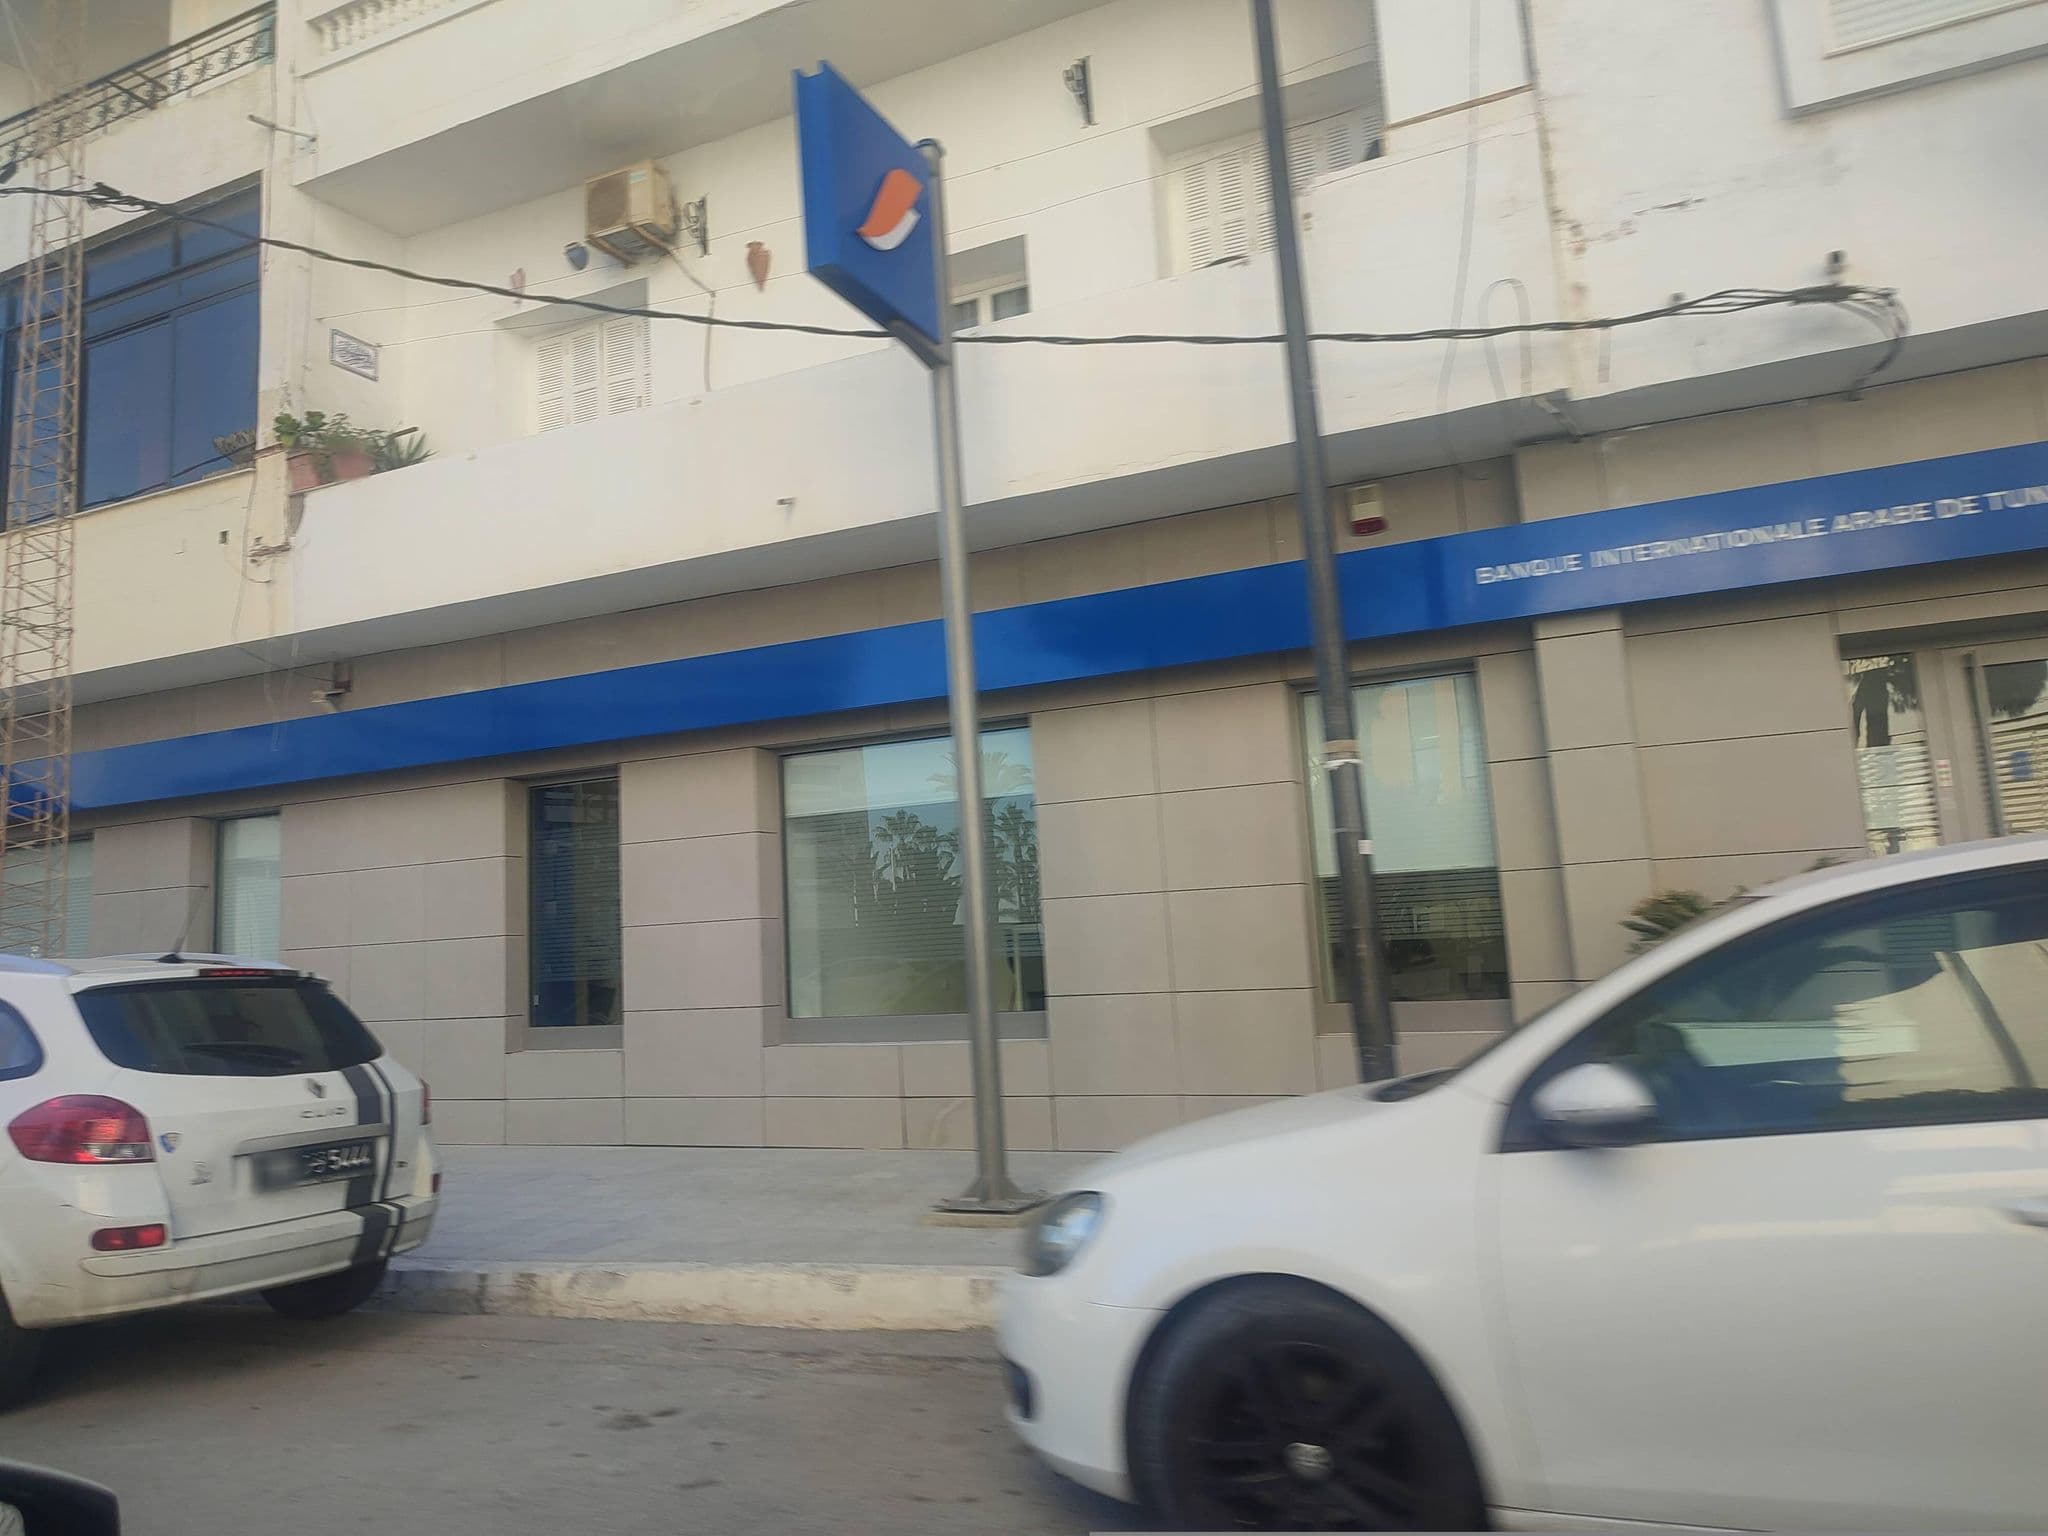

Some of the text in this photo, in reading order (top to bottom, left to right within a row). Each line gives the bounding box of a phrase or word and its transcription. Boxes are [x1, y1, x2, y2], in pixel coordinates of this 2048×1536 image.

[1475, 553, 1584, 585] BANQUE
[1590, 517, 1829, 568] INTERNATIONALE
[1830, 502, 1935, 534] ARABE
[1934, 494, 1984, 519] DE
